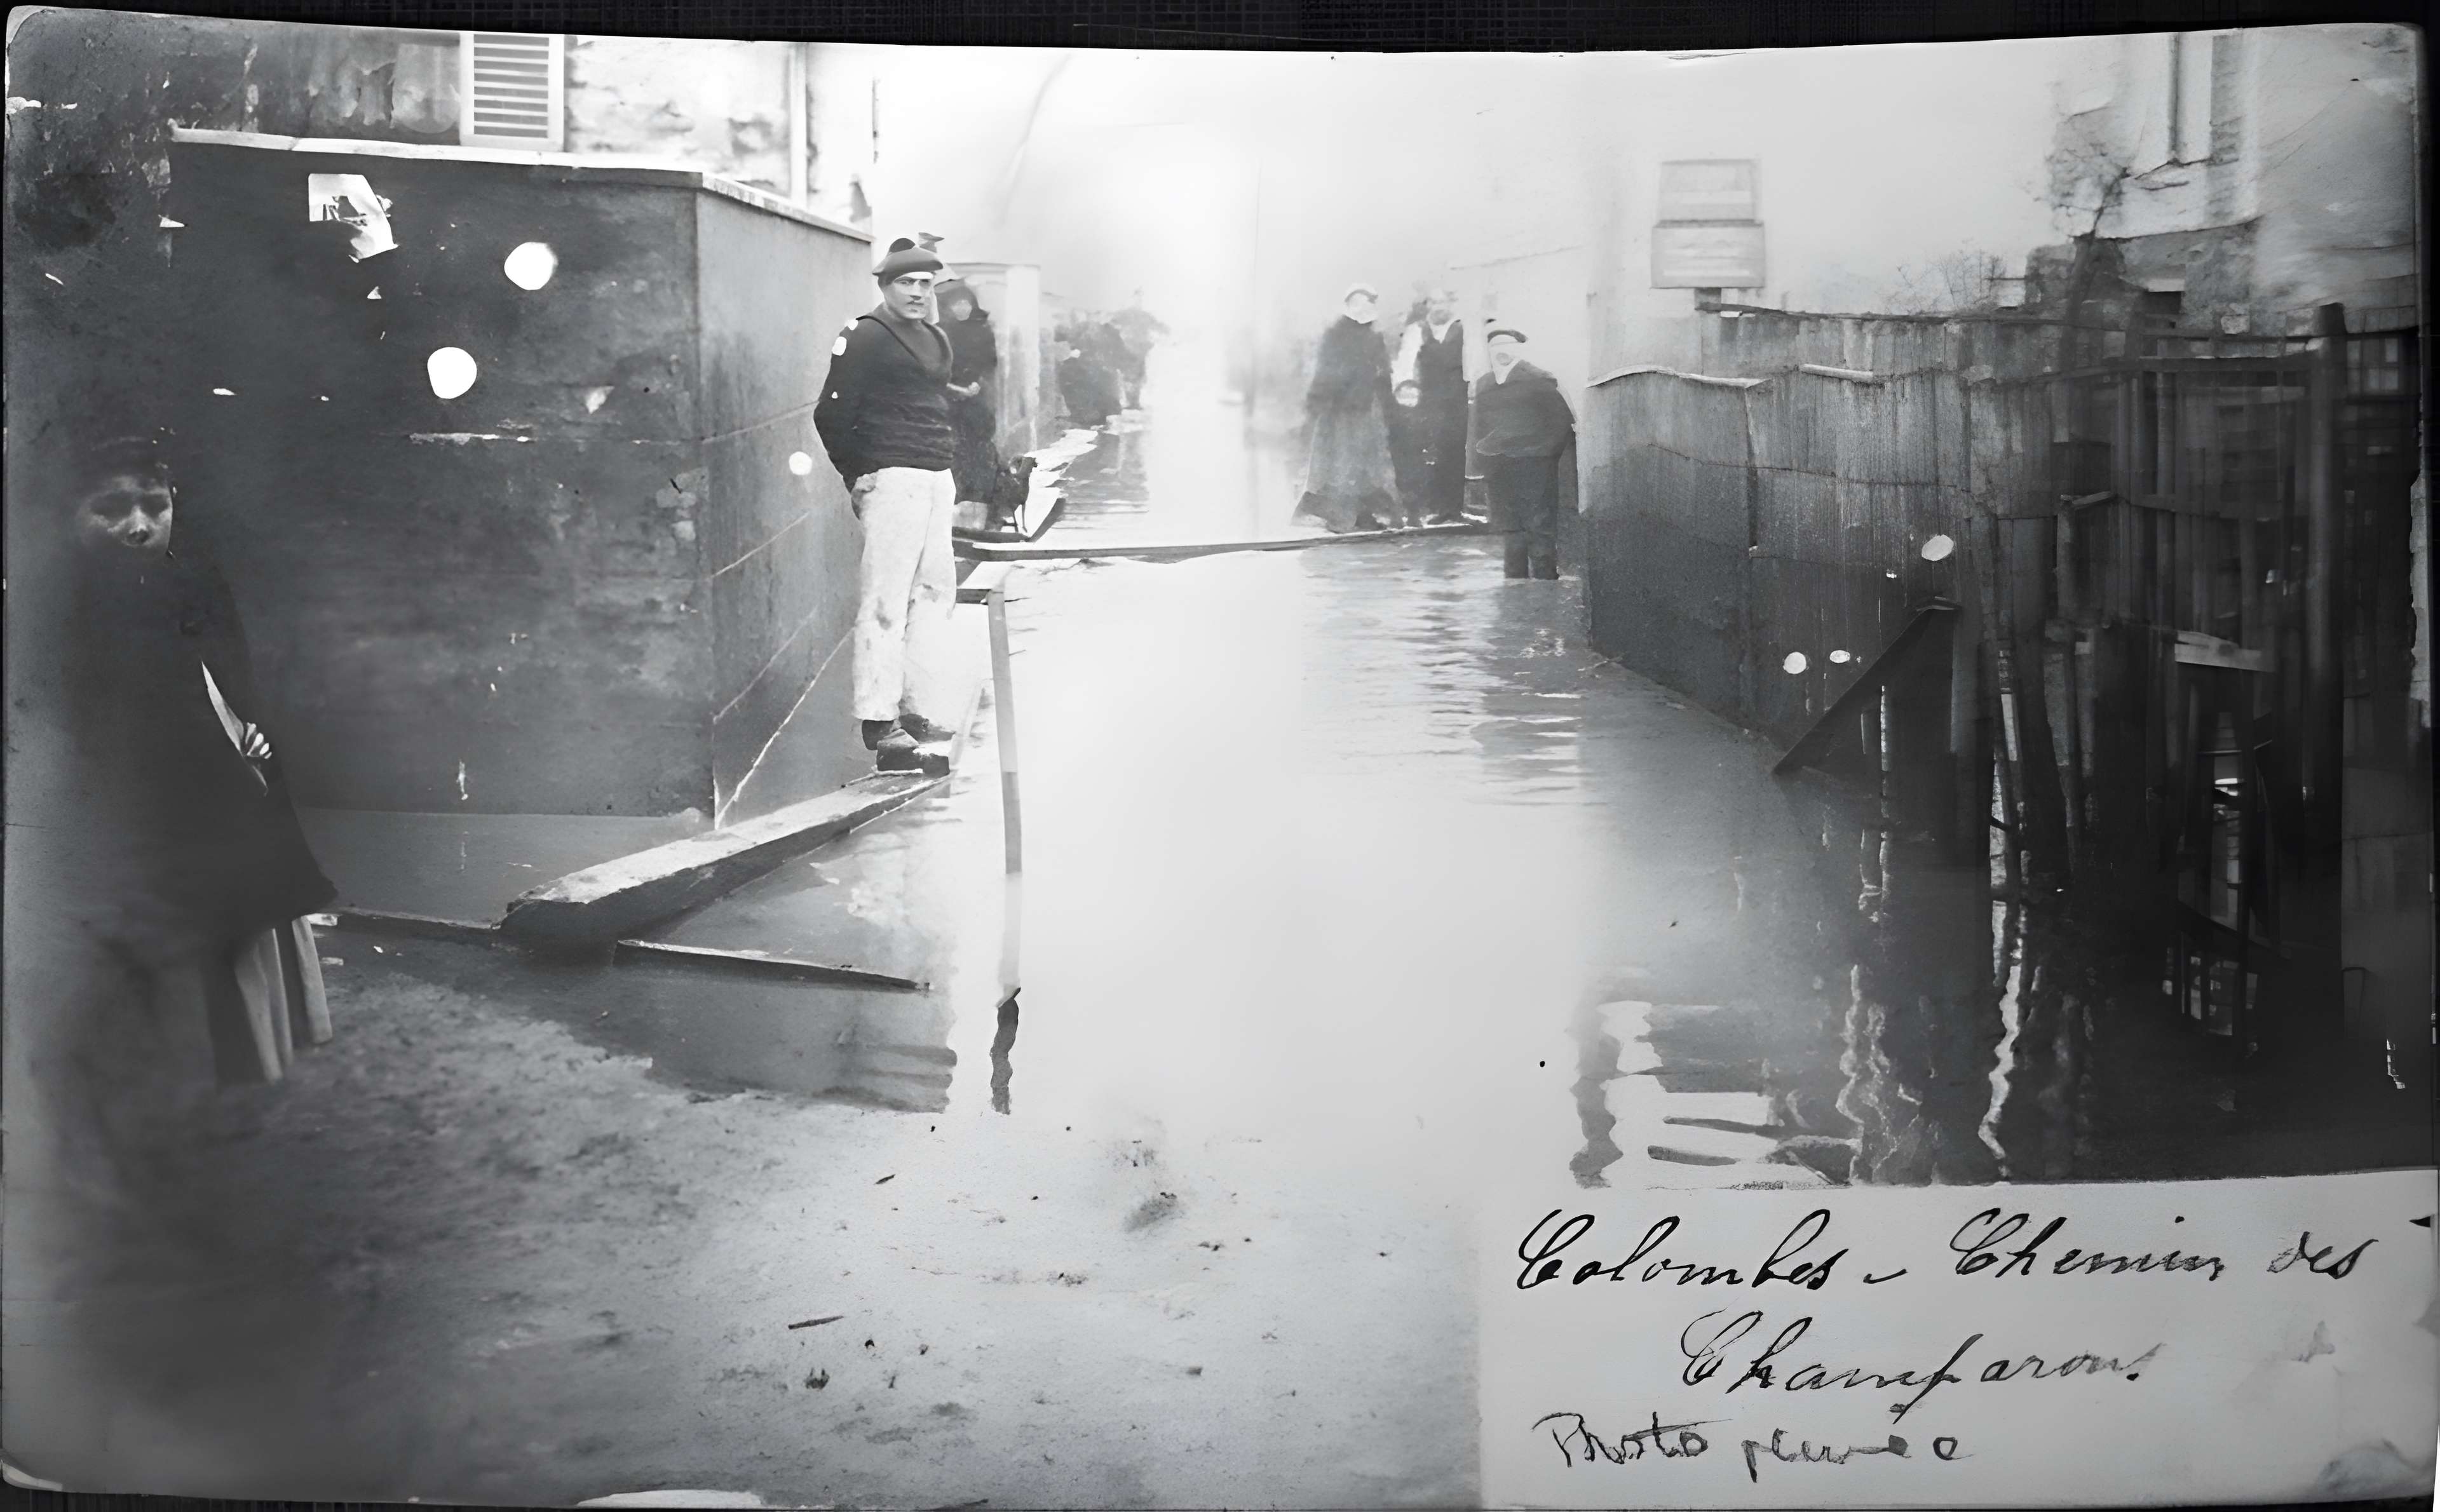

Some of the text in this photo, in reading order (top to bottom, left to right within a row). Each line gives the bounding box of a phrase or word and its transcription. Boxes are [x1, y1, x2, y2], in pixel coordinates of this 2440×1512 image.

[1517, 1209, 1848, 1289] Colombes
[1949, 1207, 2225, 1281] Chemin
[2267, 1231, 2380, 1280] des
